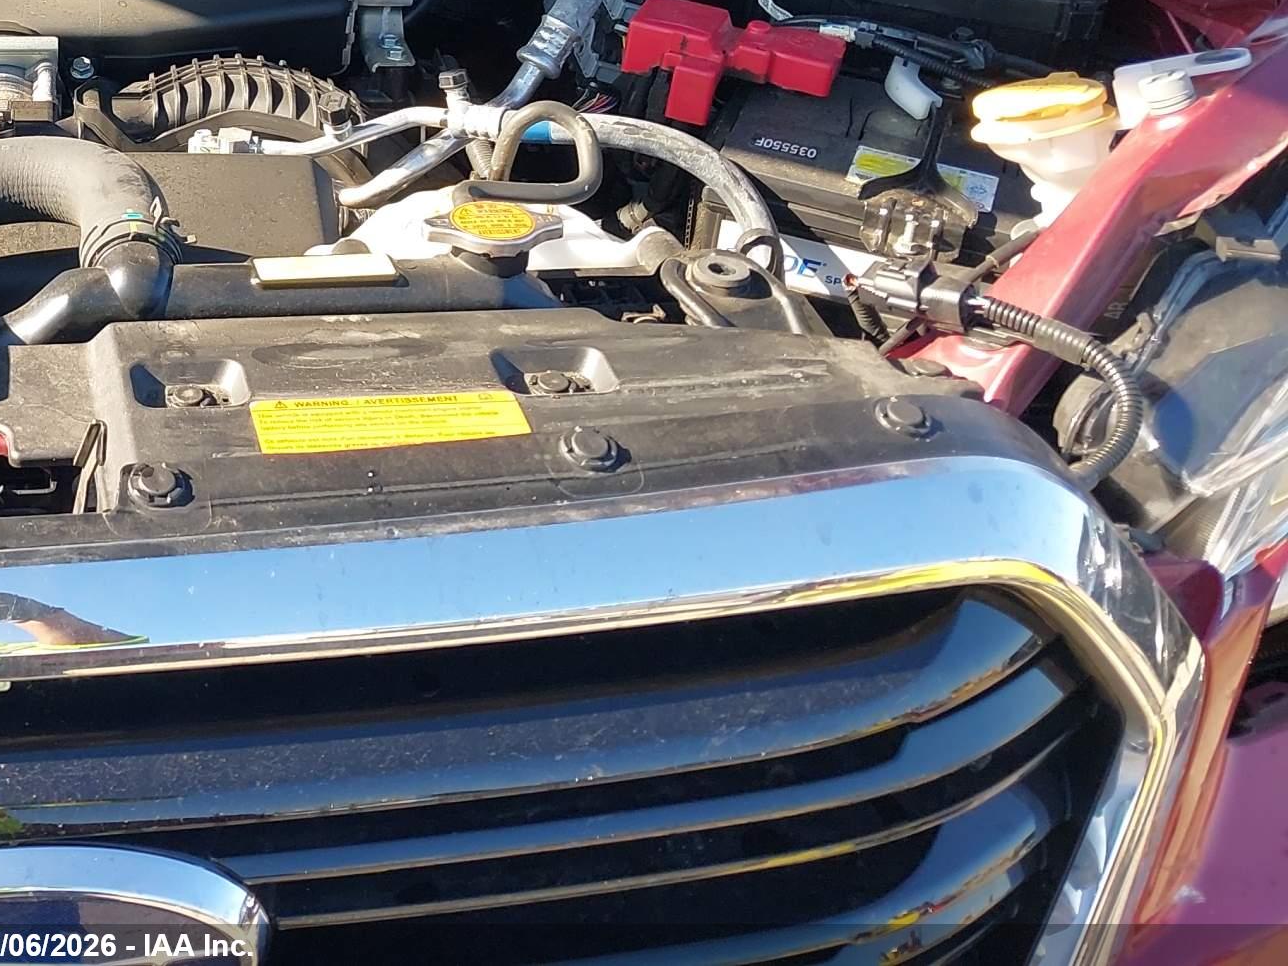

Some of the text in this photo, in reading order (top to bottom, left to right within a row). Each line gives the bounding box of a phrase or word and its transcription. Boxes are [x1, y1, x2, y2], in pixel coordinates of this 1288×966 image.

[754, 137, 817, 159] 035550F
[825, 275, 842, 285] SP
[295, 400, 349, 409] WARNING
[363, 395, 459, 406] AVERTISSEMENT
